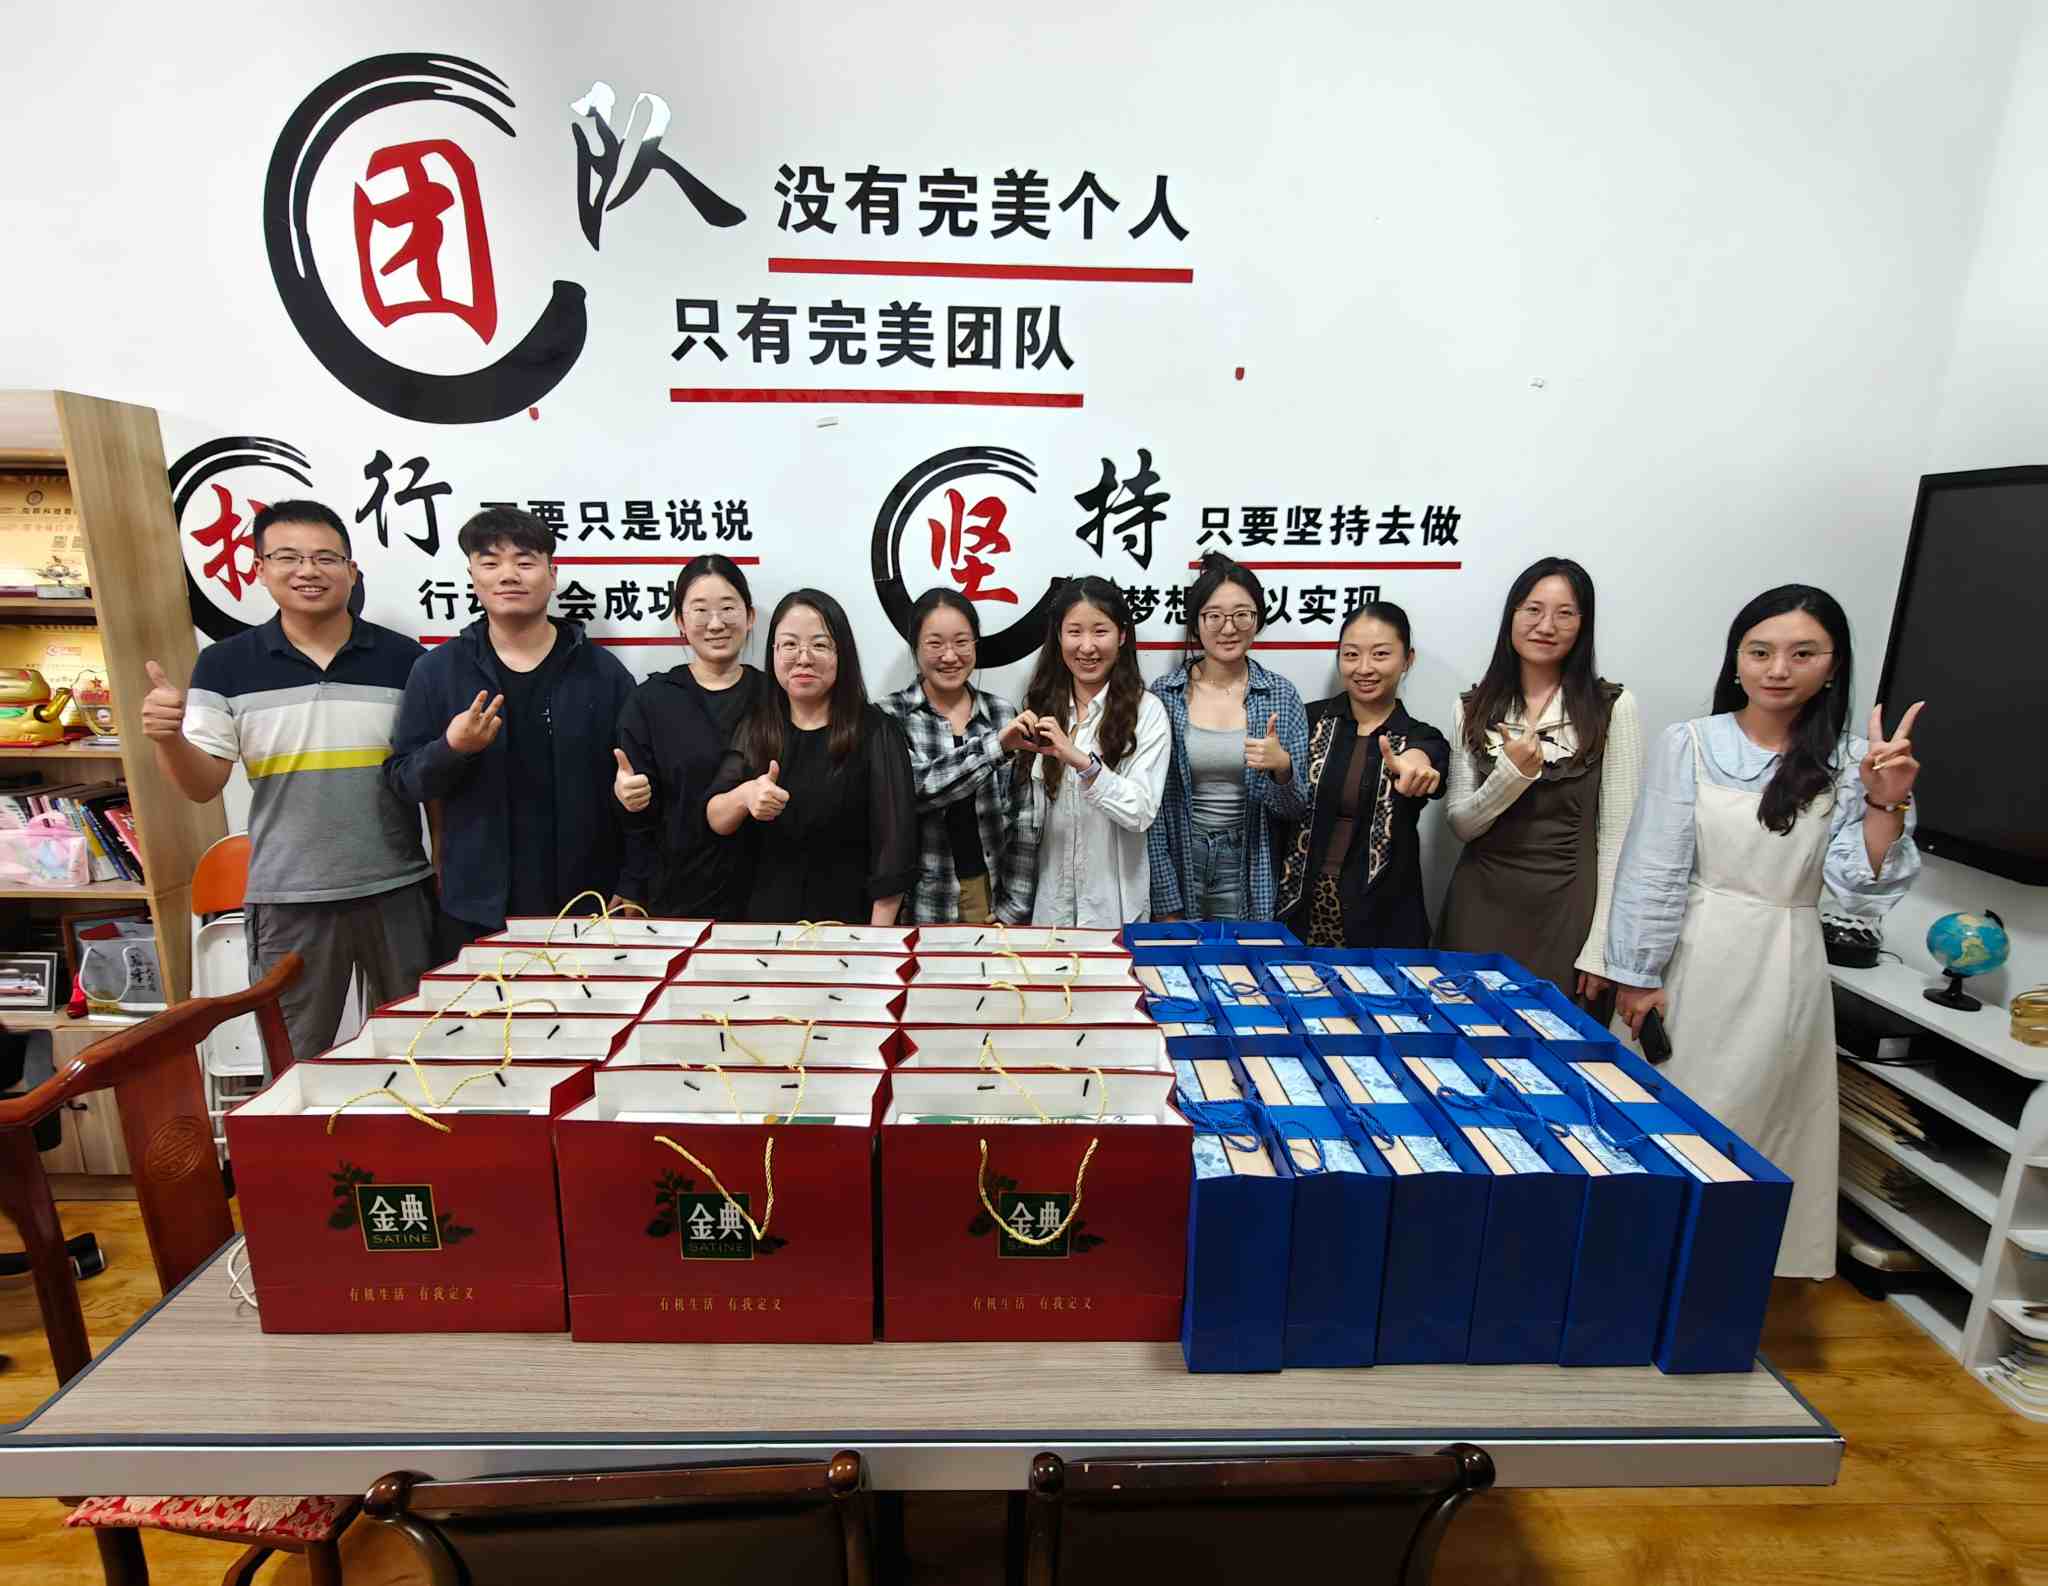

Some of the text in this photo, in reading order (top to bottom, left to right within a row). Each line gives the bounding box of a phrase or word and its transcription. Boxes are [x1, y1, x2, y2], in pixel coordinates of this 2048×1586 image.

[773, 165, 1190, 241] 没有完美个人
[672, 297, 1075, 372] 只有完美团队
[480, 500, 753, 542] 要只是说说
[1197, 505, 1462, 547] 只要坚持去做
[368, 1194, 429, 1232] 金典
[687, 1202, 745, 1240] 金典
[372, 1233, 433, 1244] SATINE
